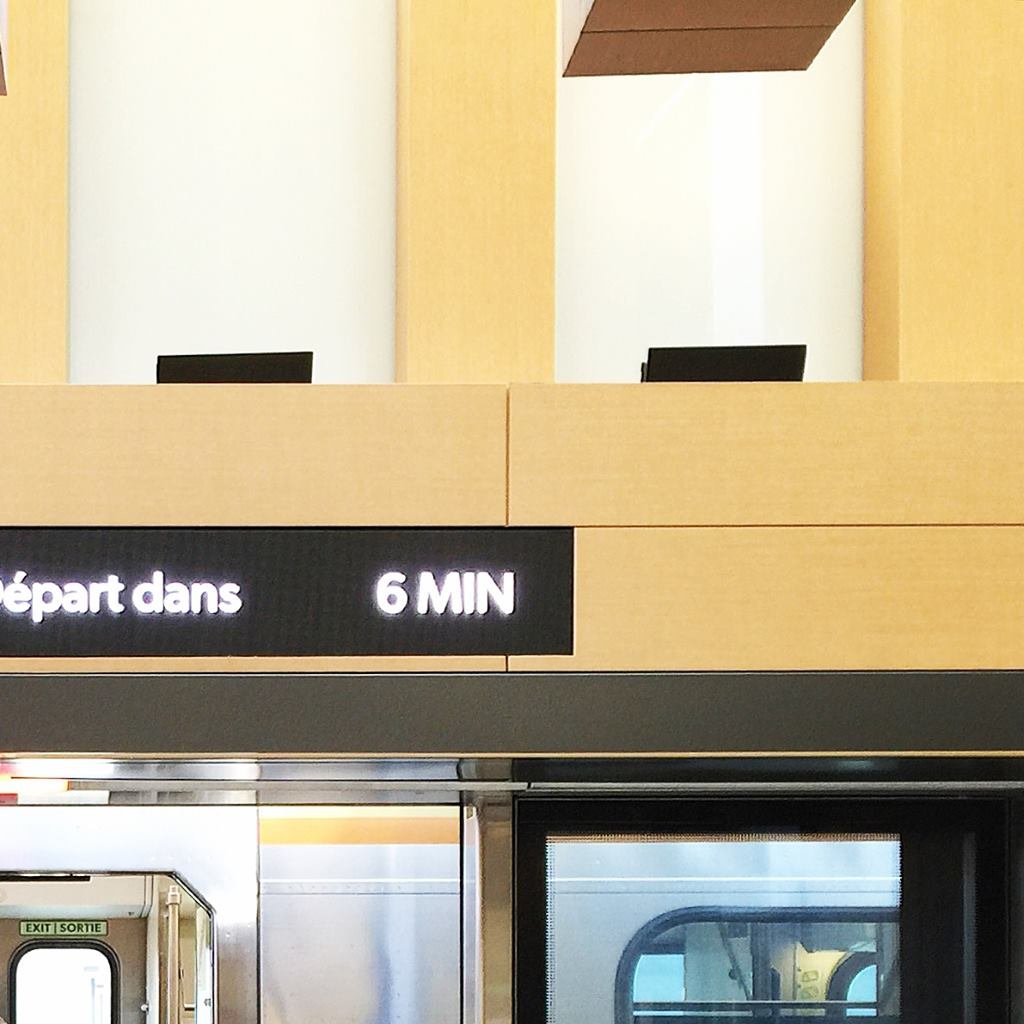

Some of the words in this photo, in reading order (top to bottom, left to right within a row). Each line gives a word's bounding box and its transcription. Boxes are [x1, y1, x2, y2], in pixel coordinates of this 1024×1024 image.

[131, 569, 243, 614] dans
[375, 571, 409, 615] 6
[415, 571, 515, 615] MIN
[25, 923, 52, 933] EXIT
[60, 923, 102, 933] SORTIE
